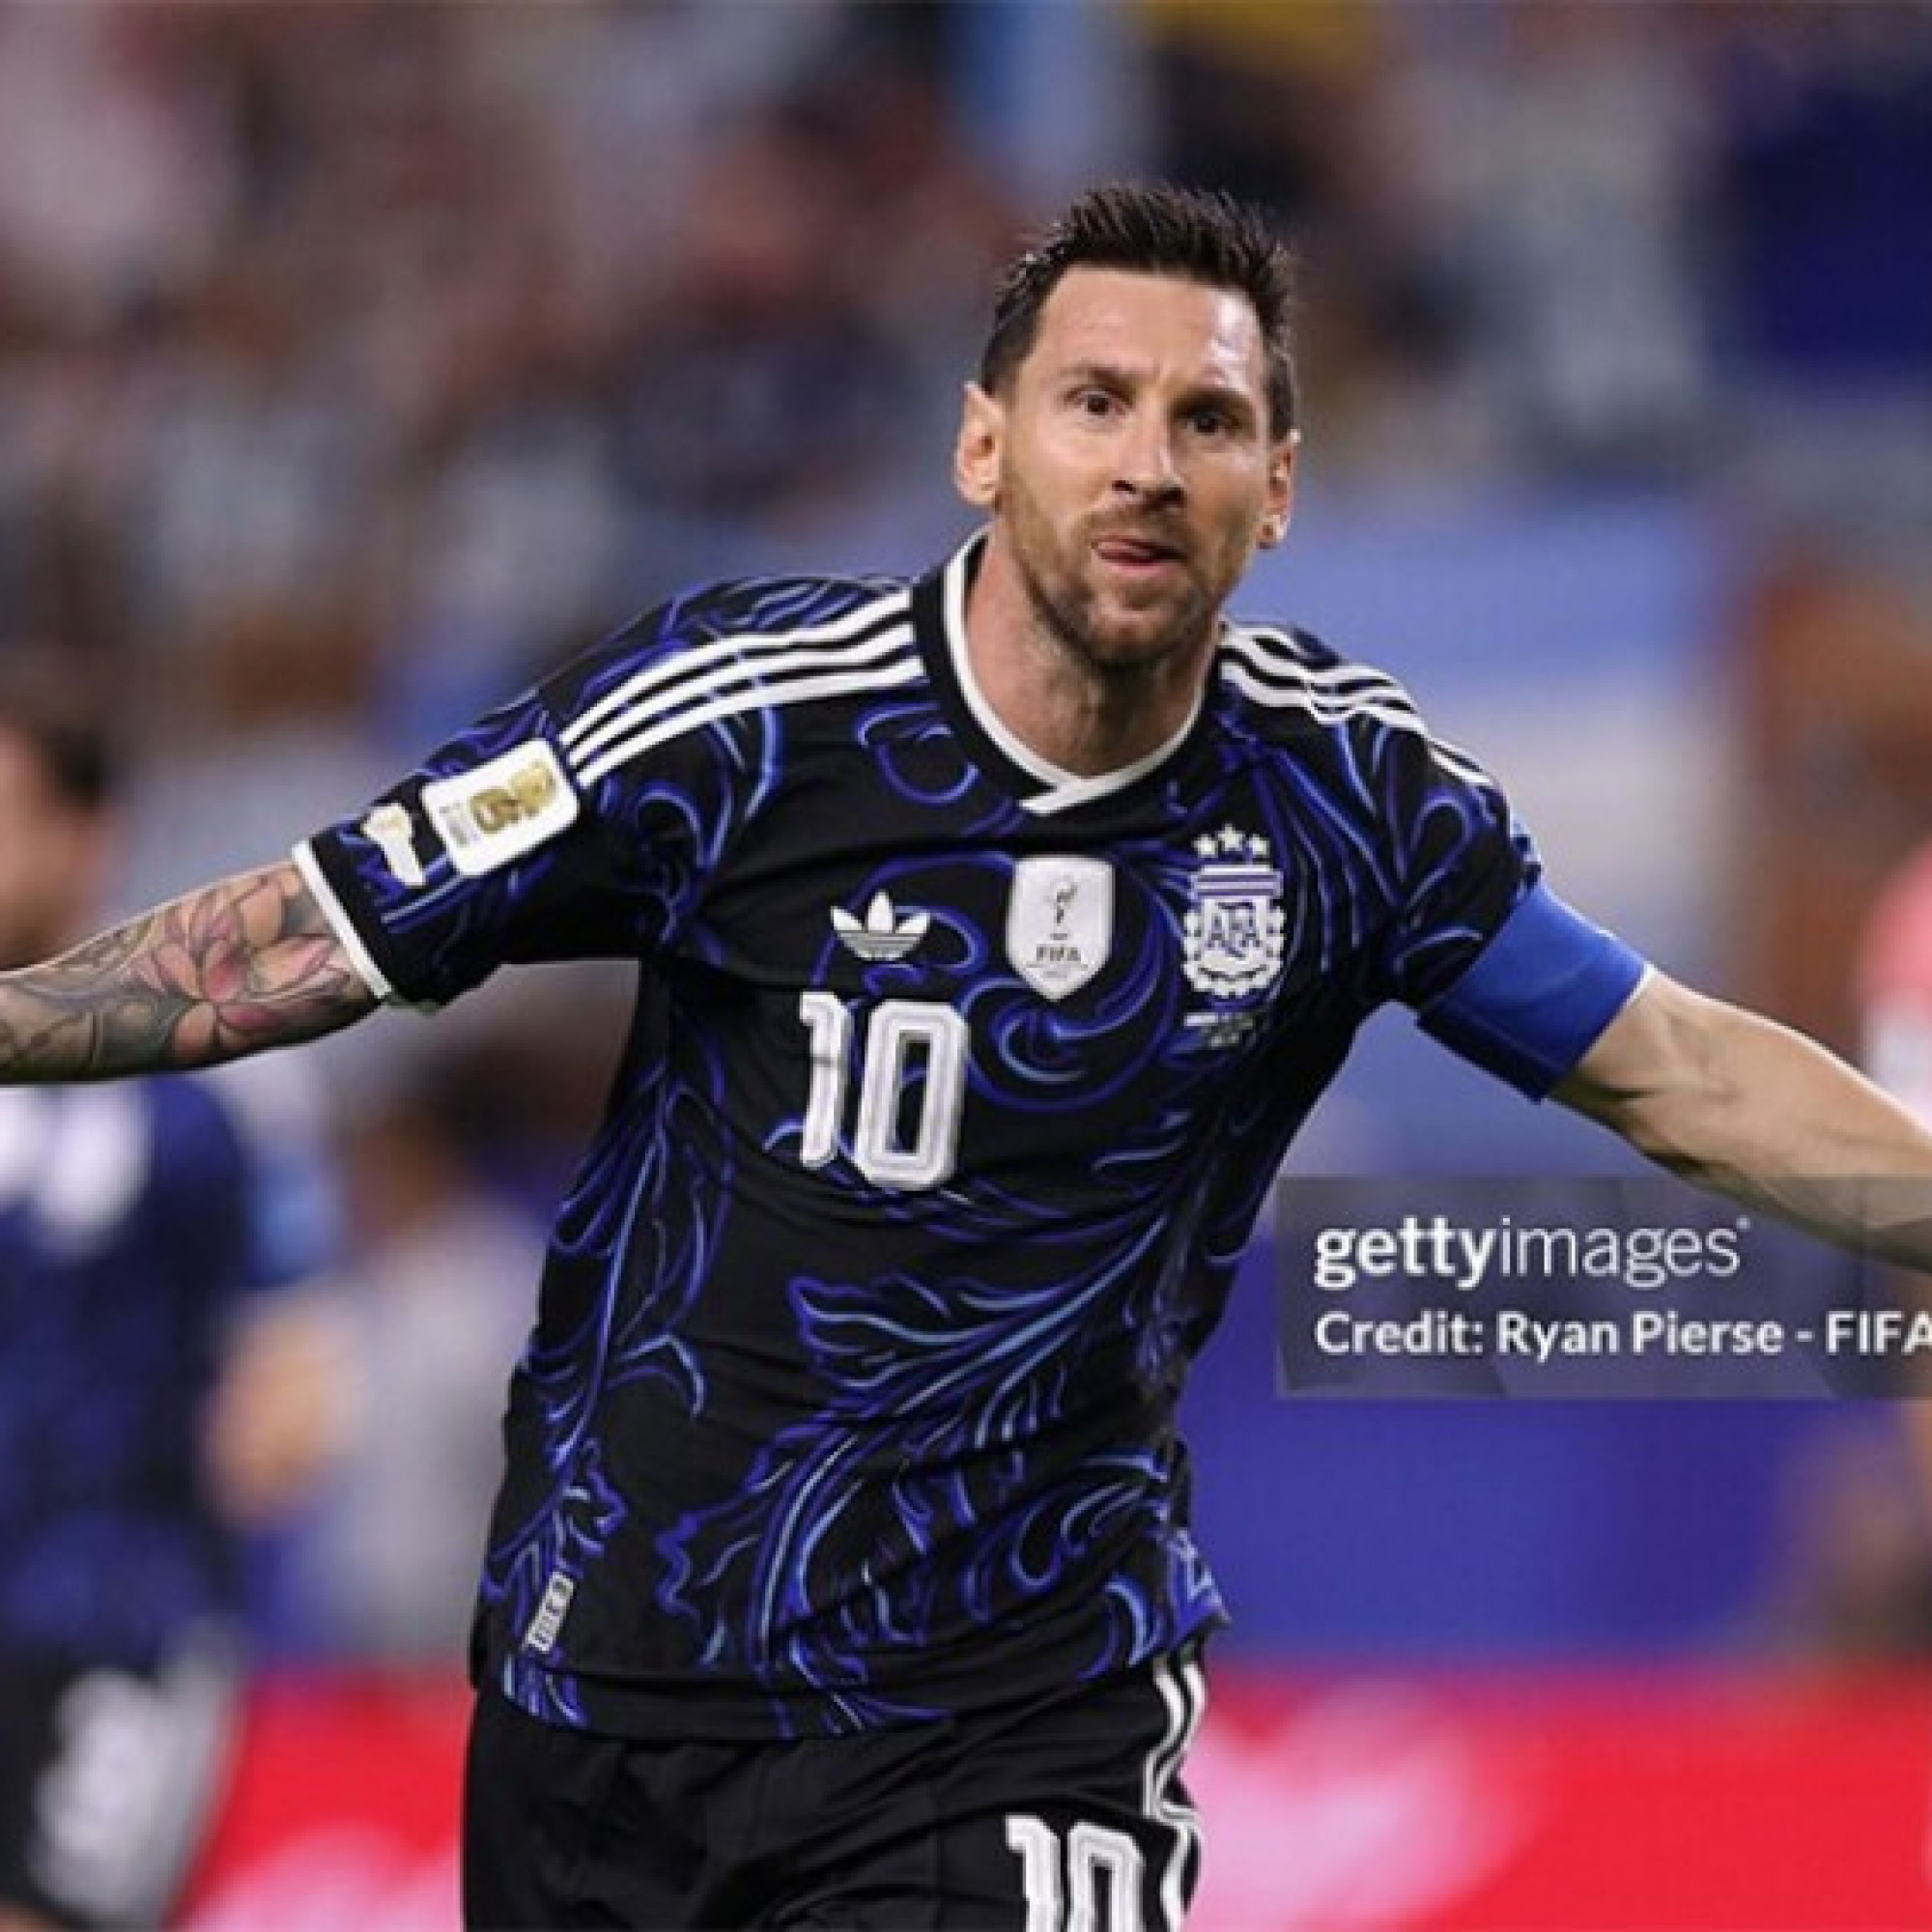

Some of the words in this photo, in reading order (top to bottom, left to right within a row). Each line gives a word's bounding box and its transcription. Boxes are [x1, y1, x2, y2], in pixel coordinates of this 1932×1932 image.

[1036, 943, 1081, 961] FIFA
[799, 991, 968, 1189] 10
[1006, 1815, 1146, 1932] 10
